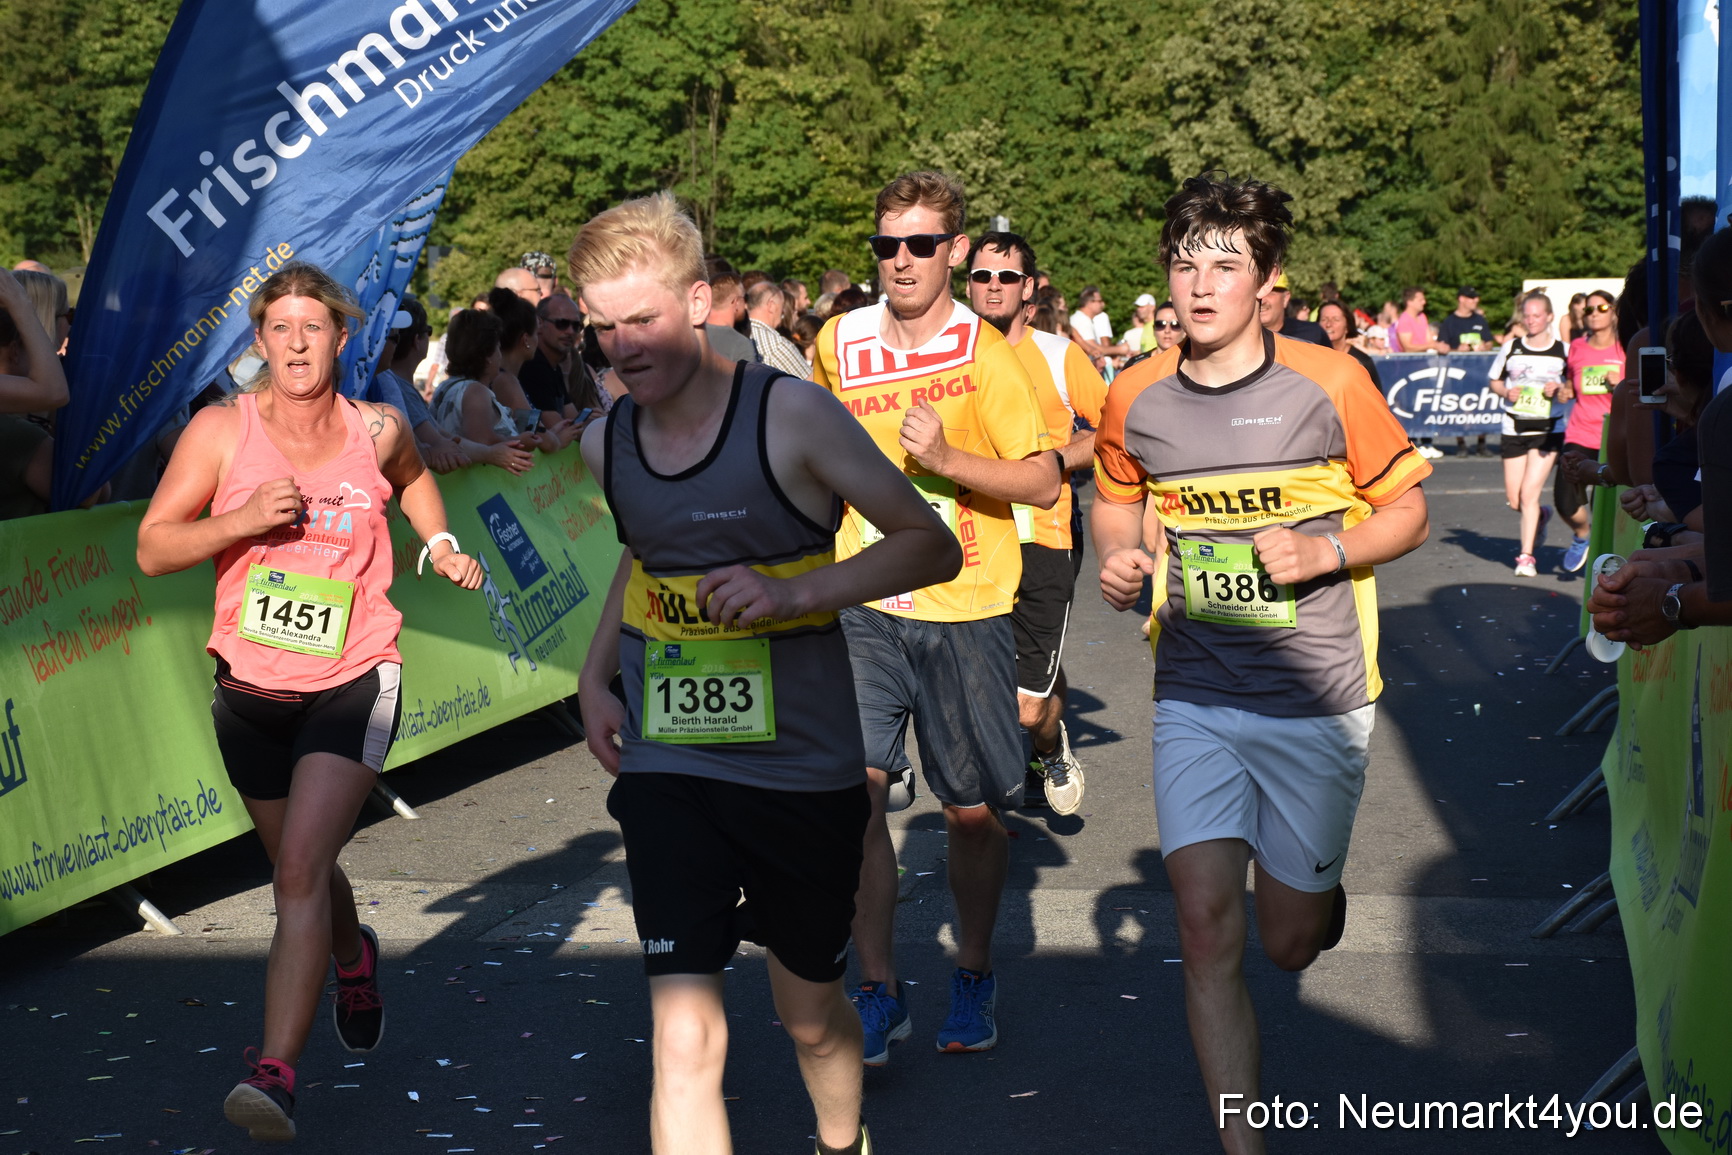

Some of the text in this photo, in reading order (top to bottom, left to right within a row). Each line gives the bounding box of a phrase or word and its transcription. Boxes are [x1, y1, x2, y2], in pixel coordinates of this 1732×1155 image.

[393, 28, 486, 109] Druck
[843, 374, 977, 417] MAX BÖGL
[497, 522, 520, 545] Fischer
[1242, 515, 1258, 524] aus
[48, 545, 114, 598] Firmen
[1195, 570, 1279, 603] 1386
[509, 548, 590, 642] firmenlauf
[1207, 600, 1269, 612] Schneider Lutz
[80, 576, 152, 656] länger!
[257, 595, 331, 635] 1451
[681, 626, 719, 637] Präzision
[261, 623, 322, 643] Engl Alexandra
[534, 624, 568, 663] neumarkt
[657, 677, 754, 715] 1383
[658, 726, 678, 734] Müller
[679, 726, 729, 734] Präzisionsteile
[672, 715, 738, 725] Bierth Harald
[648, 938, 675, 954] Rohr
